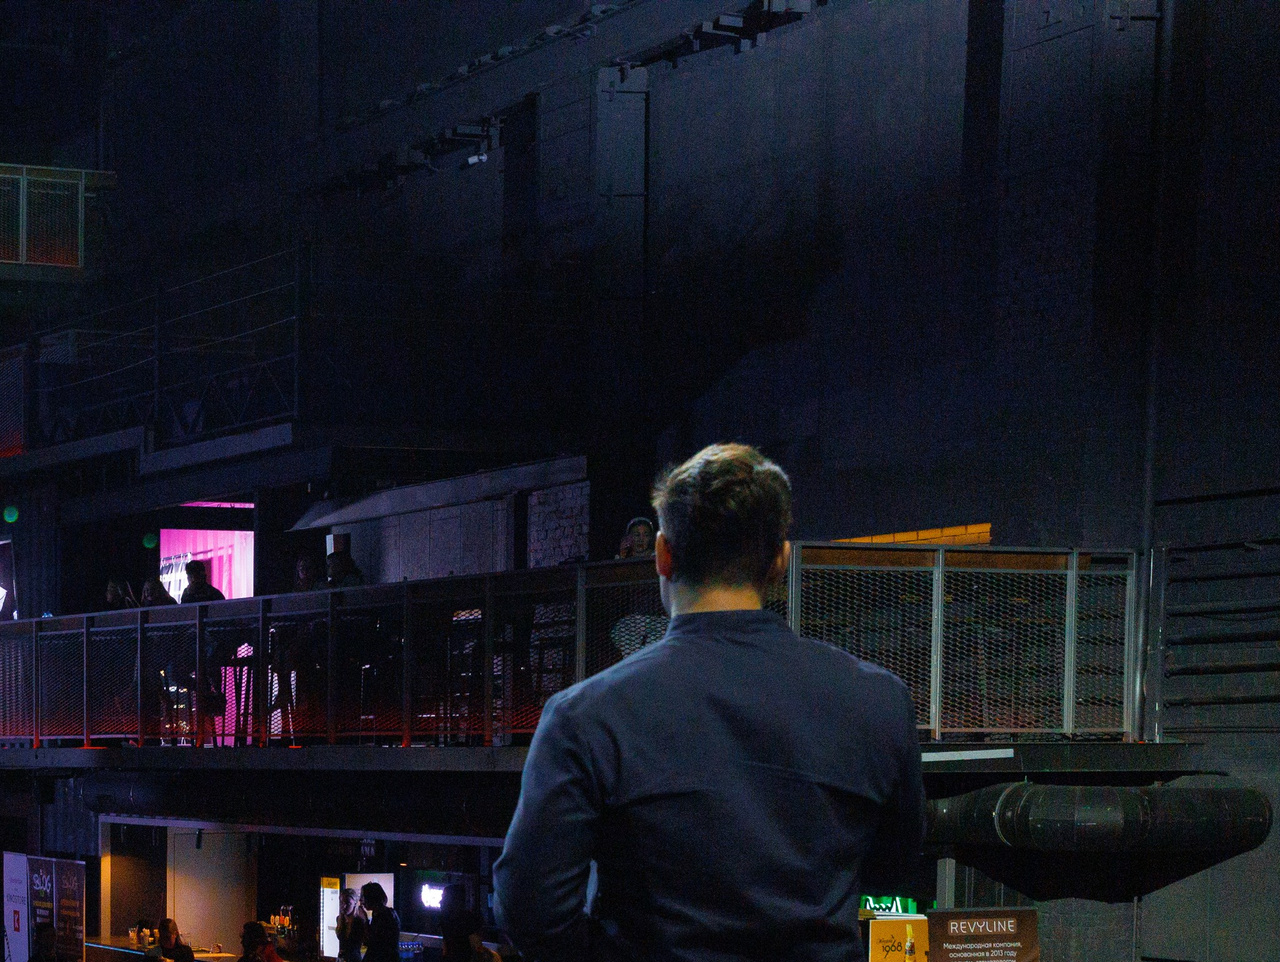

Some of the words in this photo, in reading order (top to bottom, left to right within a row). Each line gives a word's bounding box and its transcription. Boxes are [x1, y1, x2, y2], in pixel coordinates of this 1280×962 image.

[950, 920, 1015, 934] REVYLINE
[943, 942, 992, 951] Международная
[990, 949, 1004, 957] 2013
[1004, 950, 1018, 958] году
